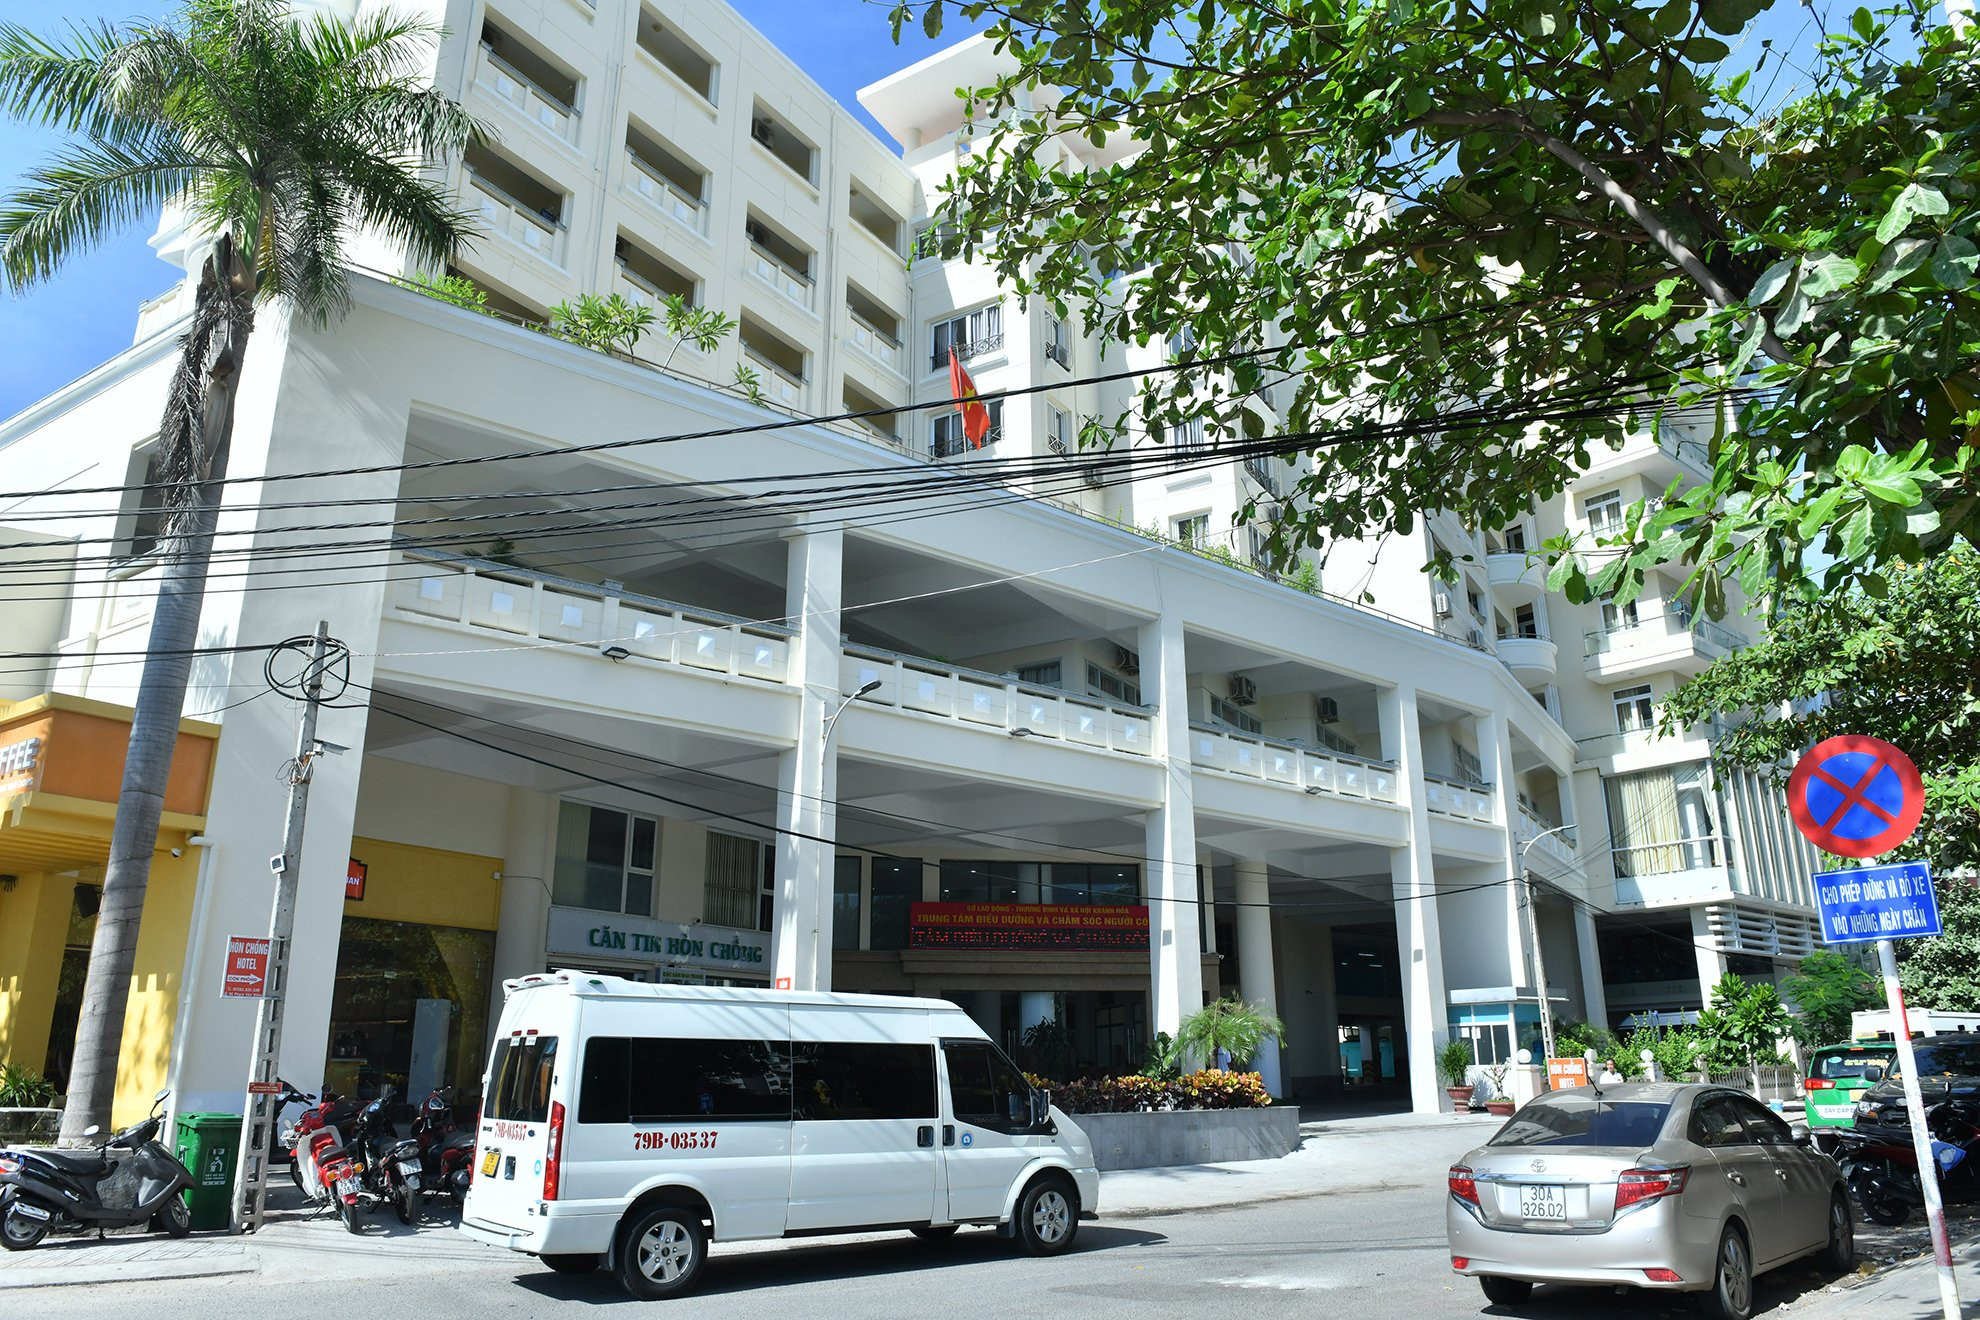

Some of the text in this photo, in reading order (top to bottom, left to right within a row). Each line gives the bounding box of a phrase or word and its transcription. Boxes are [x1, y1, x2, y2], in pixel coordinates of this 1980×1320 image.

[1822, 885, 1839, 906] CHO
[1840, 880, 1861, 904] PHÉP
[1863, 875, 1887, 901] DỪNG
[1886, 875, 1899, 899] VÀ
[1912, 876, 1927, 896] XE
[917, 915, 950, 923] TRUNG
[953, 912, 973, 924] TÂM
[1037, 914, 1050, 925] VÀ
[1052, 914, 1081, 926] CHĂM
[1832, 912, 1849, 936] VÀO
[1850, 910, 1880, 934] NHỮNG
[1879, 907, 1902, 932] NGÀY
[588, 925, 626, 950] CĂN
[631, 933, 662, 953] TIN
[667, 933, 703, 957] HÒN
[236, 957, 257, 970] HOTEL
[1530, 1186, 1554, 1202] 30A
[1522, 1202, 1565, 1219] 326.02
